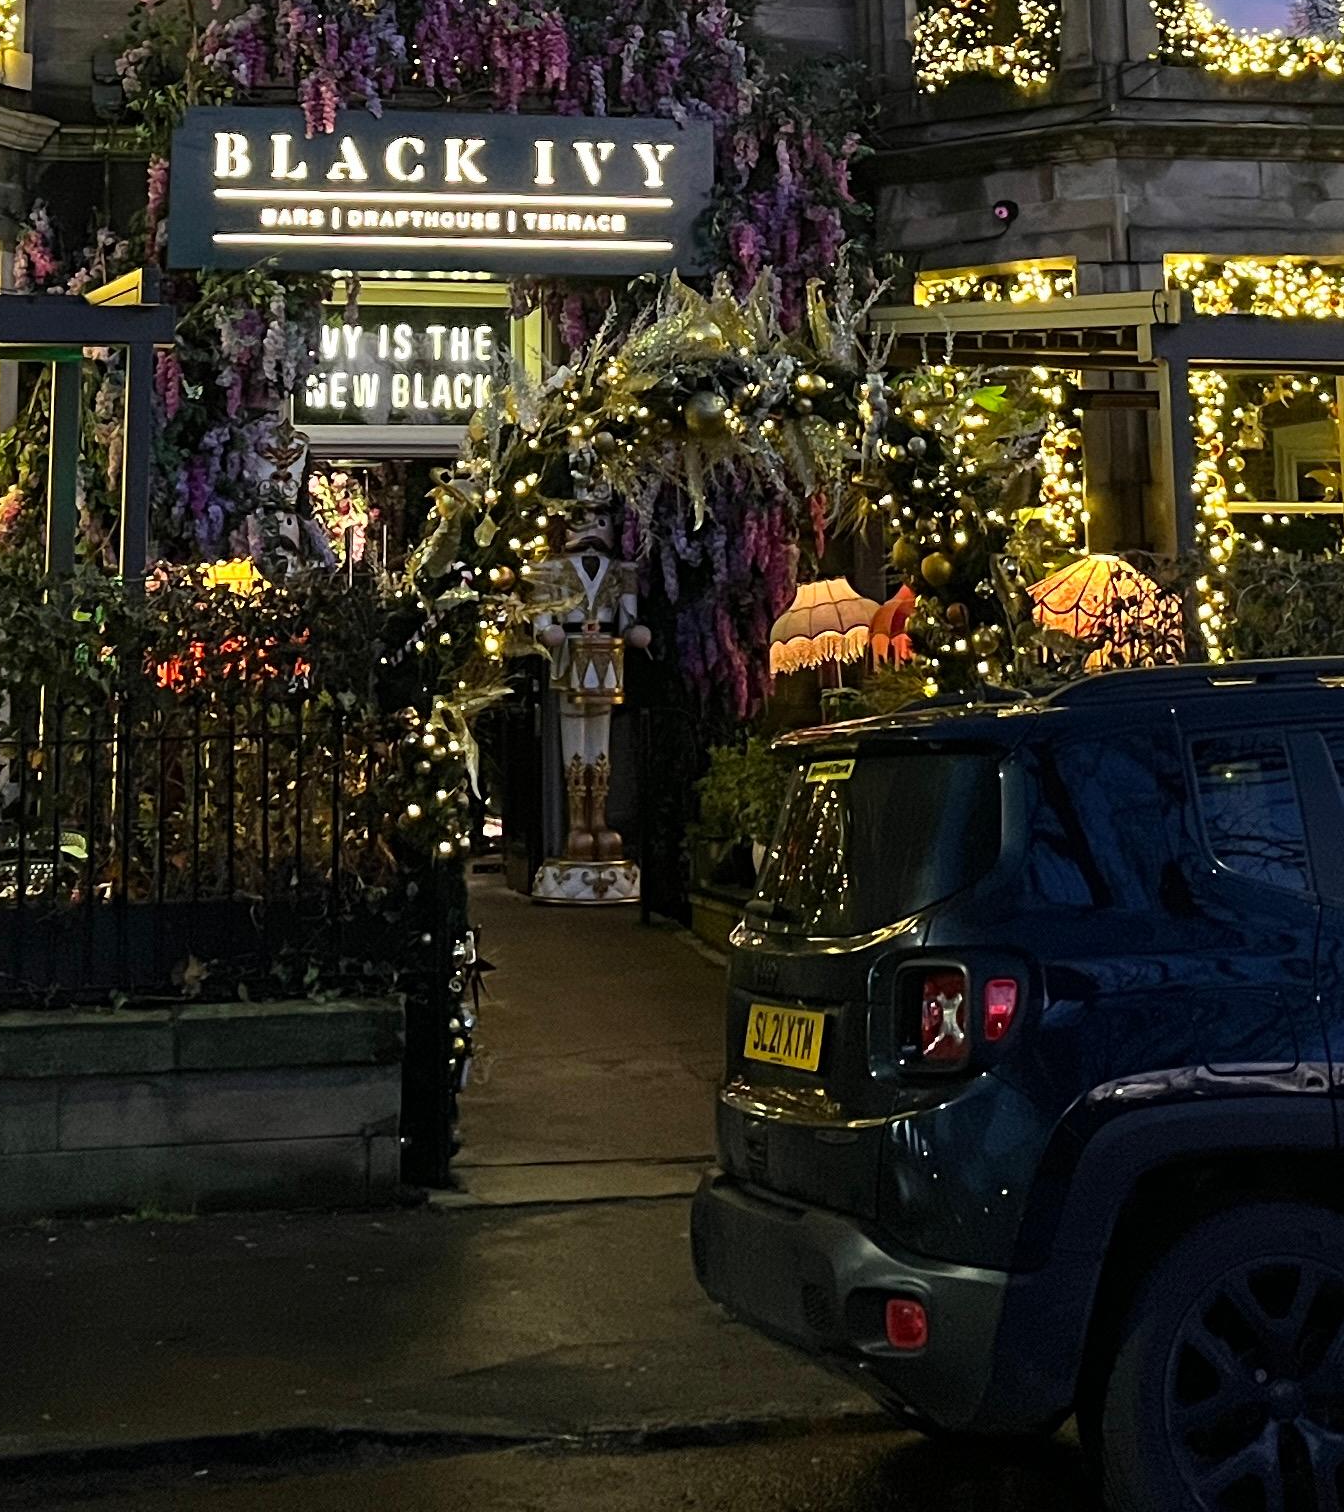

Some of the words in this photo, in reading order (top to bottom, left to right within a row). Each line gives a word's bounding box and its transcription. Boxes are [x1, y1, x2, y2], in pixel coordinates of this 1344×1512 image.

[214, 131, 488, 184] BLACK
[533, 139, 675, 188] IVY
[260, 206, 325, 227] BARS
[347, 208, 500, 231] DRAFTHOUSE
[522, 211, 627, 233] TERRACE
[309, 323, 364, 360] VY
[377, 323, 414, 361] IS
[425, 324, 493, 361] THE
[305, 371, 380, 409] NEW
[391, 372, 494, 409] BLACK
